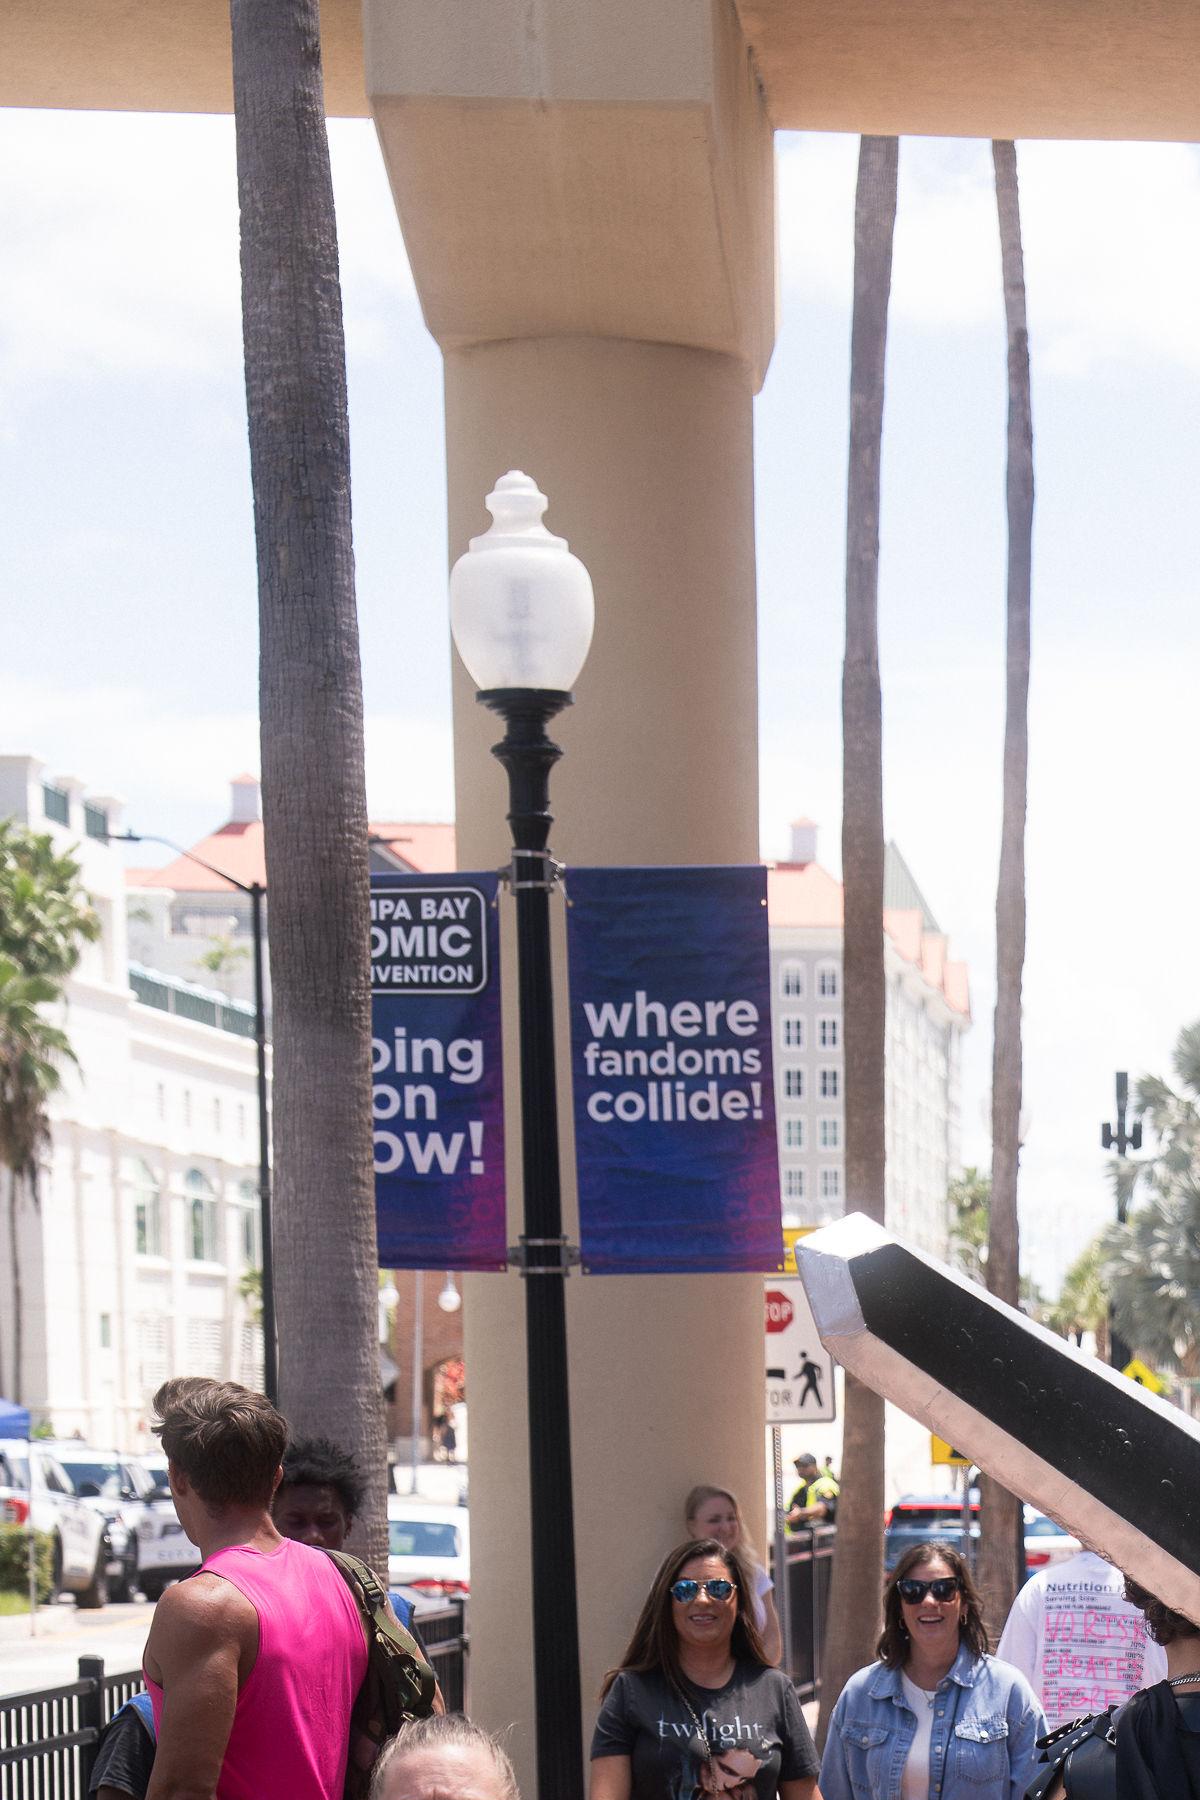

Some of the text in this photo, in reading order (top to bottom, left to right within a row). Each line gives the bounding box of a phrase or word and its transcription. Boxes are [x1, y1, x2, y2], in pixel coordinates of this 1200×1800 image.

[421, 897, 470, 920] BAY
[371, 925, 472, 958] OMIC
[371, 964, 473, 983] VENTION
[583, 991, 759, 1038] where
[372, 1026, 484, 1084] oing
[584, 1042, 761, 1077] fandoms
[373, 1084, 437, 1120] on
[587, 1081, 764, 1122] collide!
[374, 1120, 484, 1174] ow!
[768, 1390, 792, 1407] OR
[1046, 1581, 1112, 1592] Nutrition
